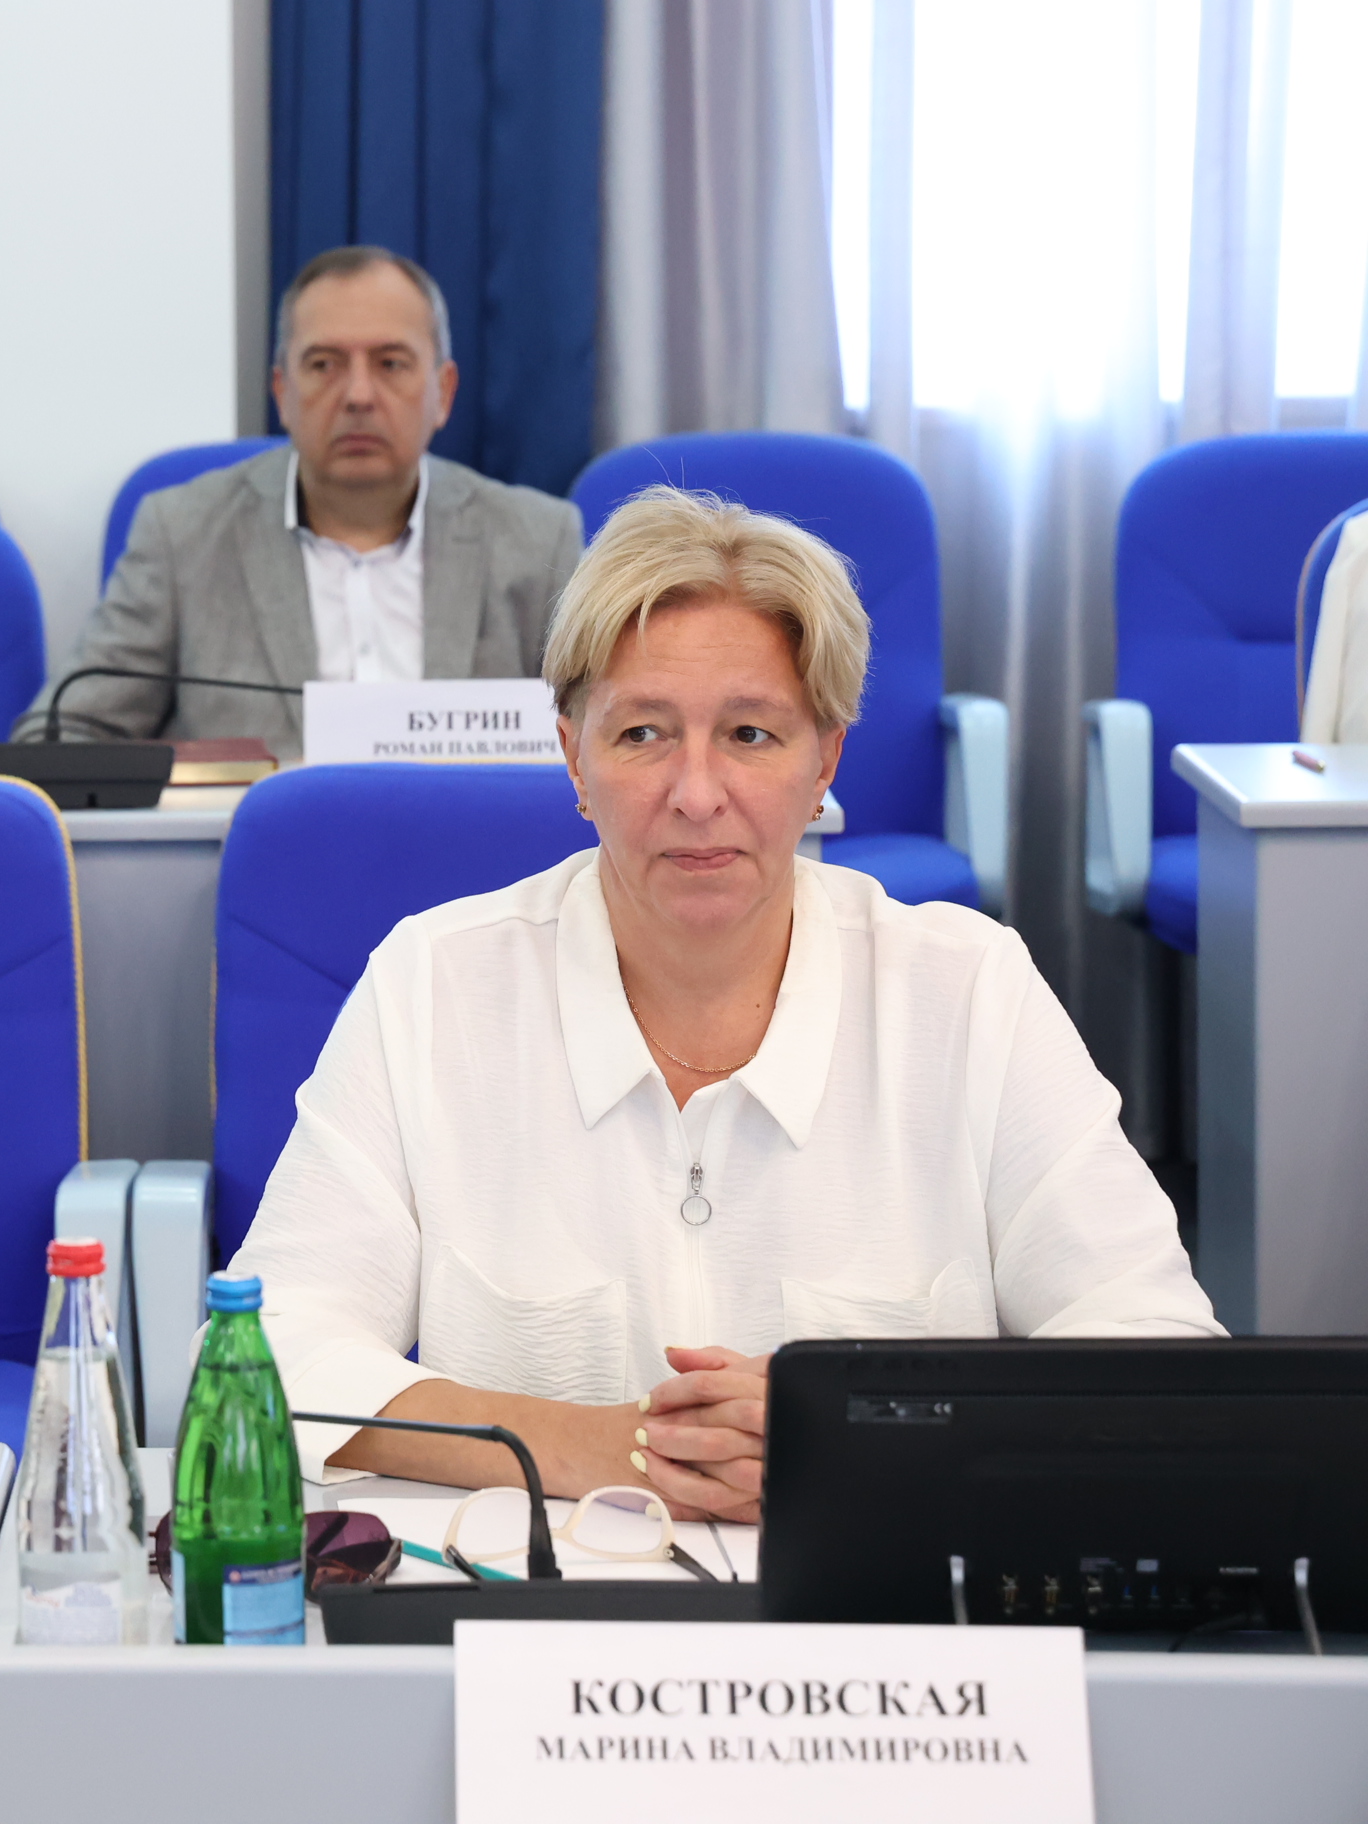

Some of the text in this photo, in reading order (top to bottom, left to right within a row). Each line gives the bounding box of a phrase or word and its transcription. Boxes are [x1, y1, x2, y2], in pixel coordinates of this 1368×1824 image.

[407, 710, 521, 732] БУГРИН
[373, 738, 557, 756] РОМАН ПАВЛОВИЧ
[569, 1679, 989, 1718] КОСТРОВСКАЯ
[536, 1736, 1028, 1765] МАРИНА ВЛАДИМИРОВНА
